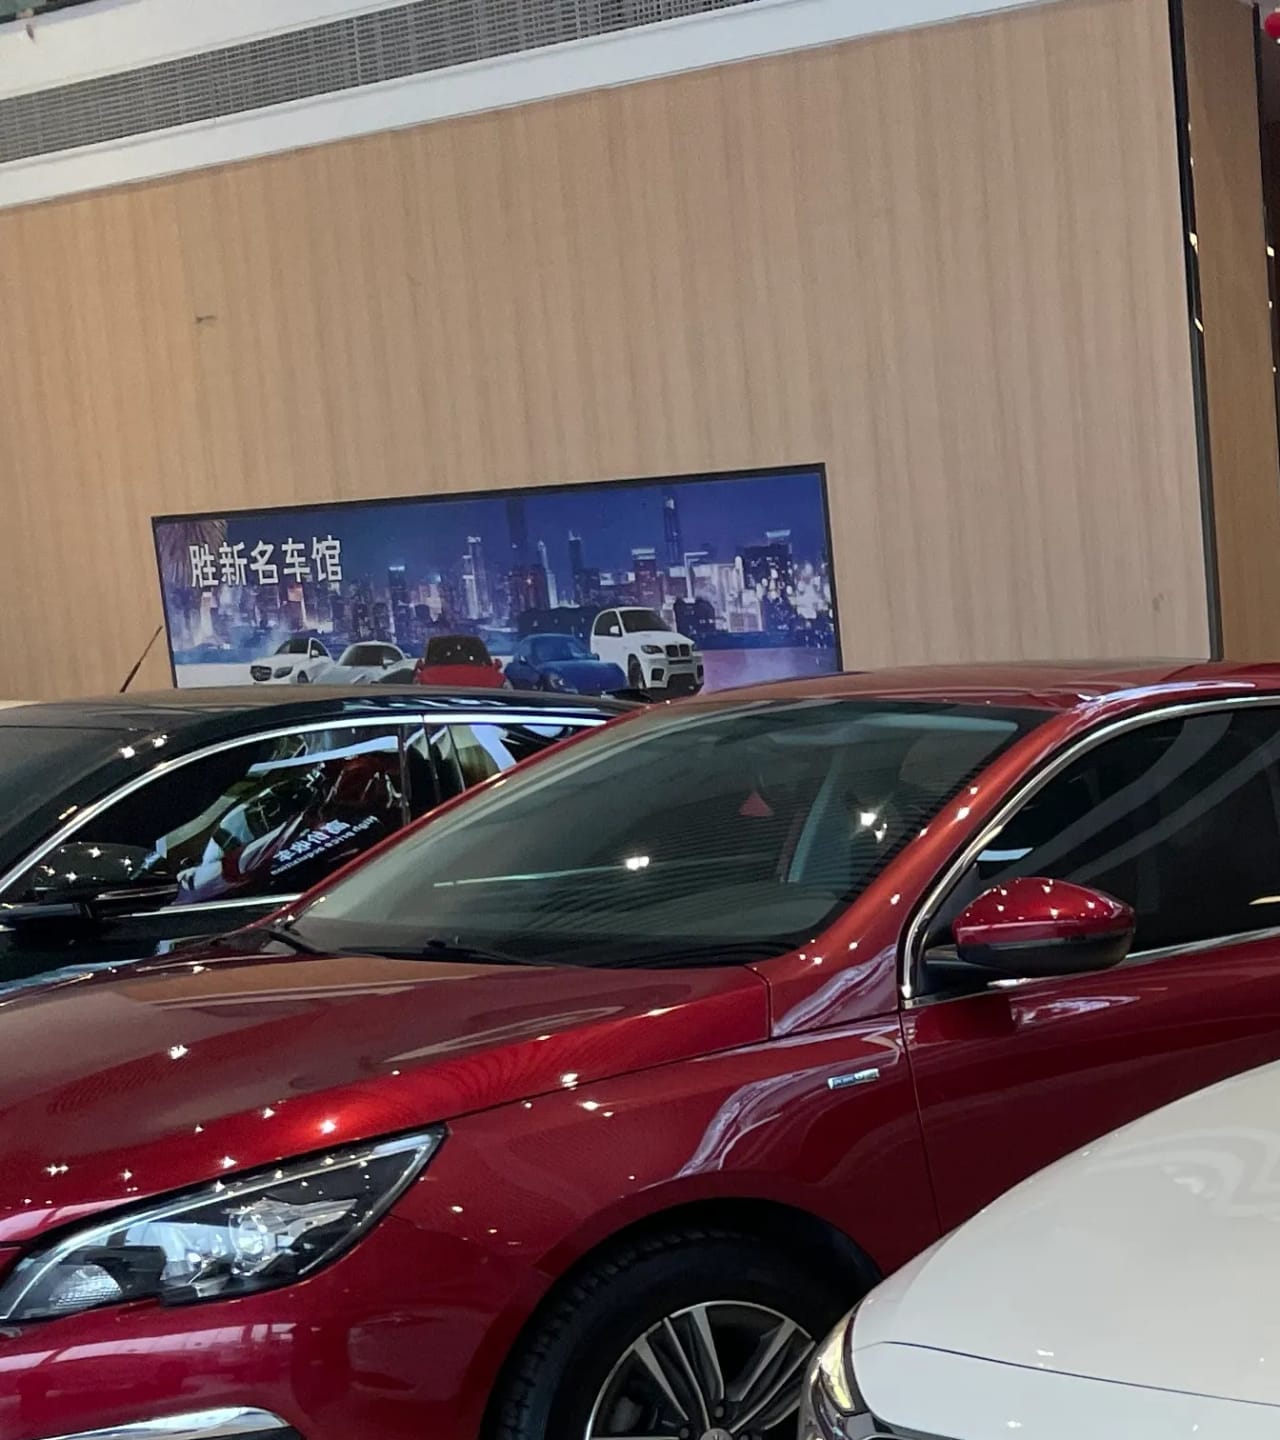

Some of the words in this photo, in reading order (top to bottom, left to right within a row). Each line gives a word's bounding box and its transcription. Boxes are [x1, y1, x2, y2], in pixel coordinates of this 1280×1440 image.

[188, 534, 344, 588] 胜新名车馆
